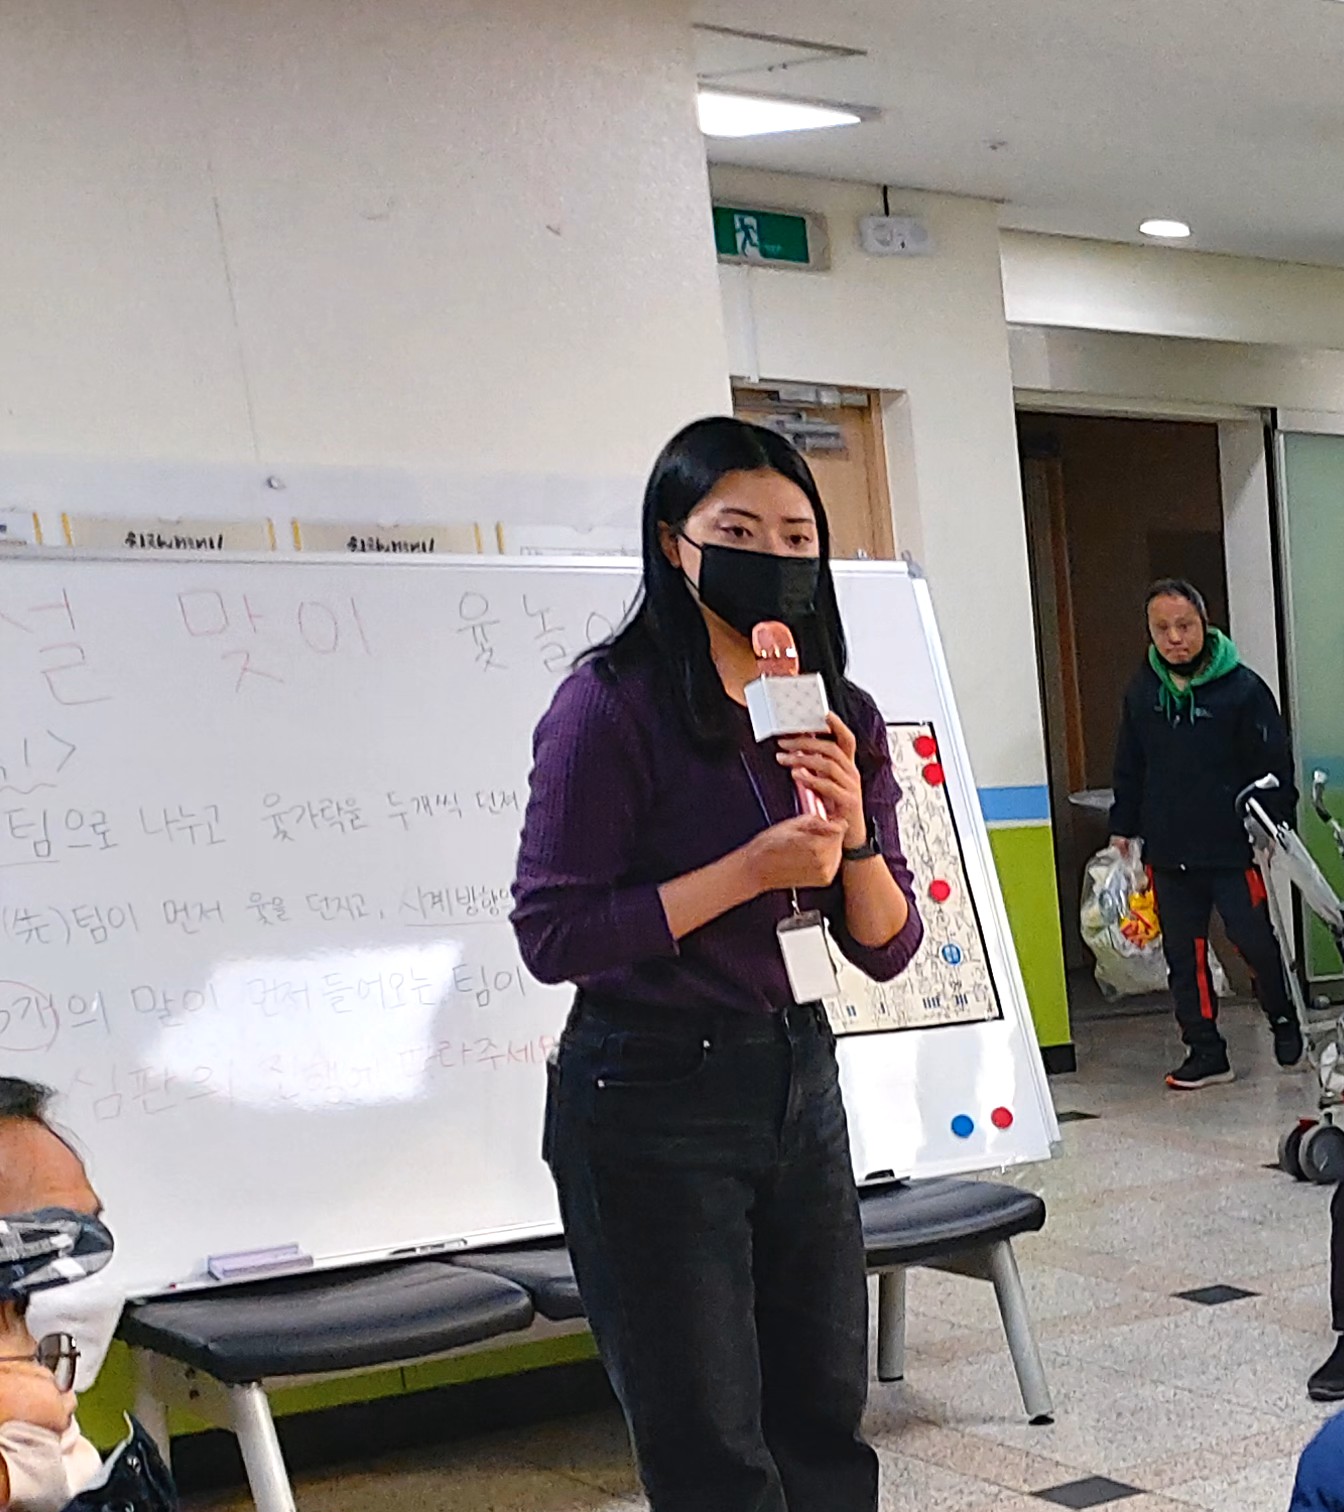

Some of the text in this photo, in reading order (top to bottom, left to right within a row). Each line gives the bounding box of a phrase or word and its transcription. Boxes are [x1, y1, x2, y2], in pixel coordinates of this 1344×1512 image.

[177, 588, 372, 693] 맞이
[138, 803, 227, 846] 나누고
[162, 898, 225, 935] 먼저
[130, 981, 220, 1027] 말이
[245, 977, 311, 1018] 먼저
[452, 961, 526, 1008] 팀이
